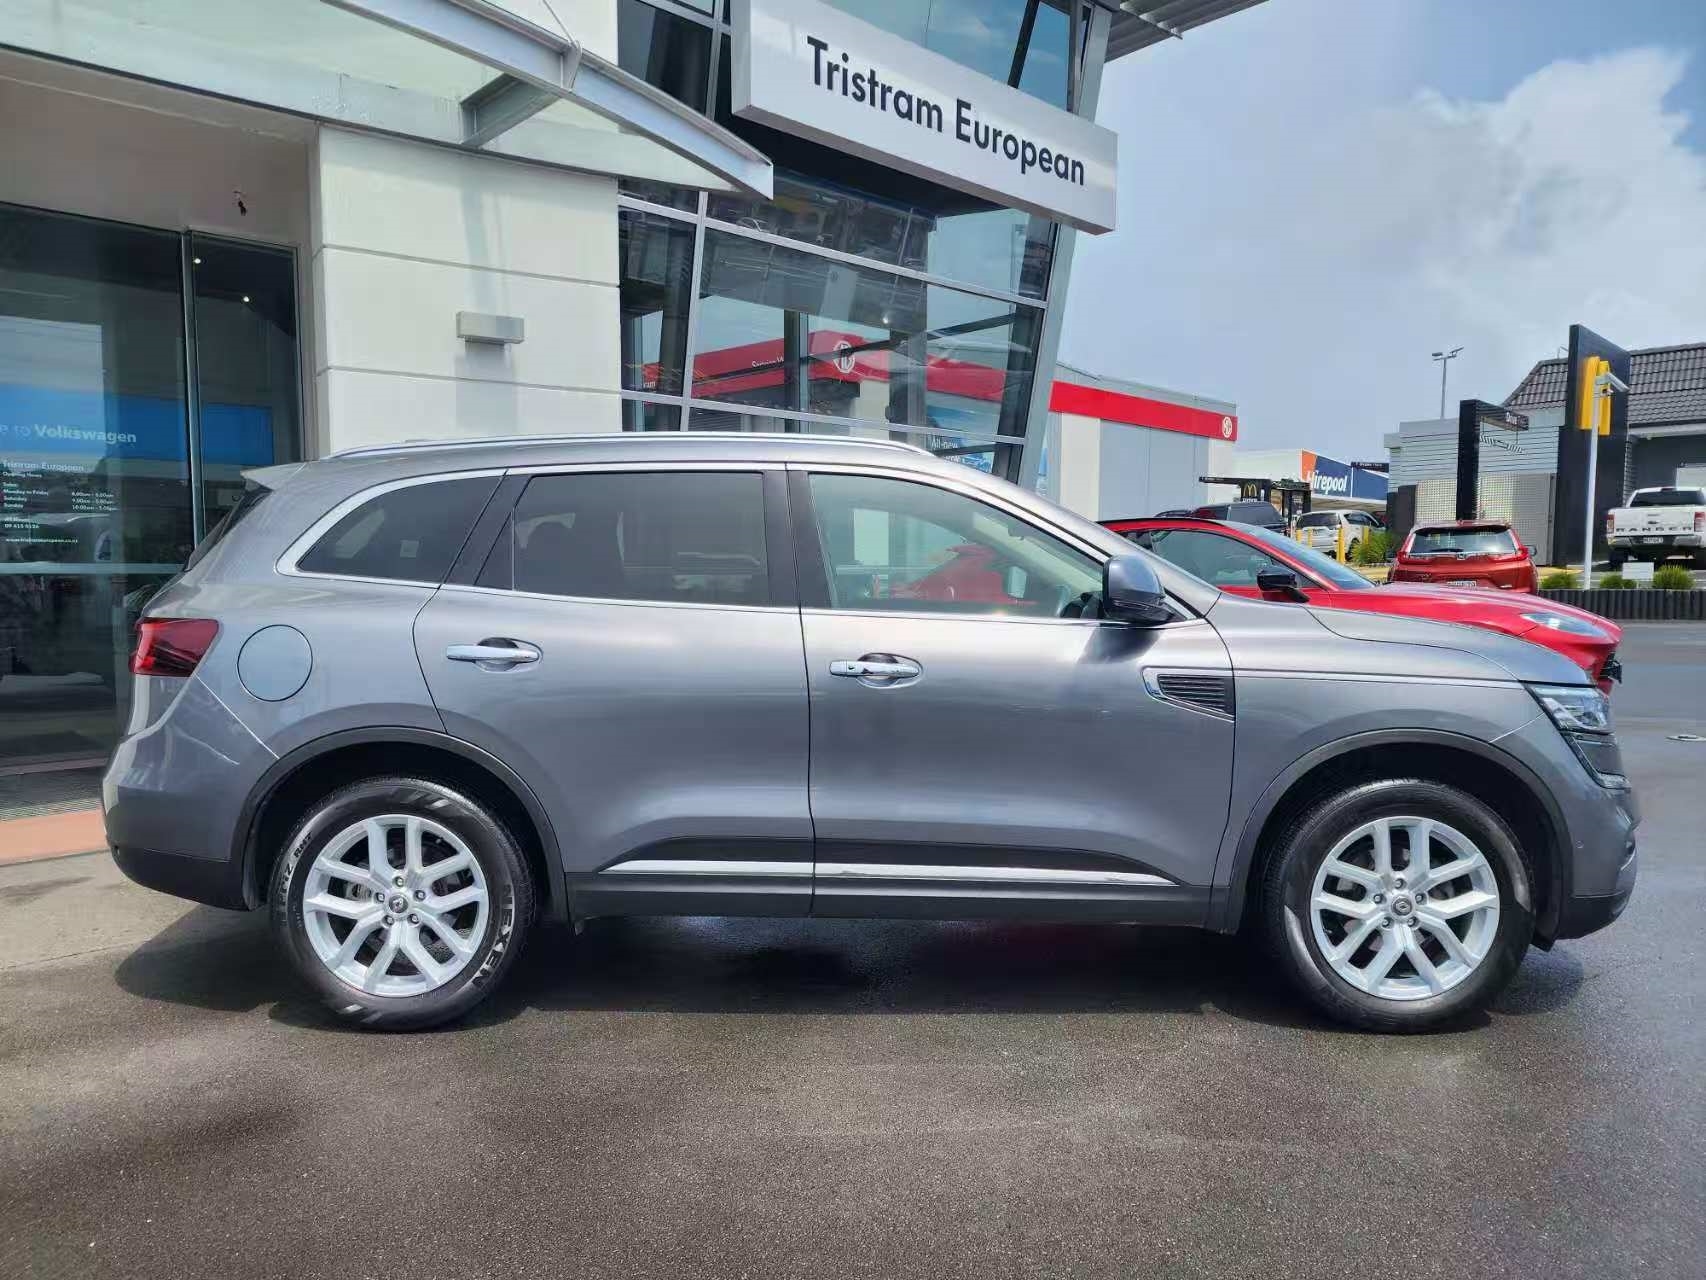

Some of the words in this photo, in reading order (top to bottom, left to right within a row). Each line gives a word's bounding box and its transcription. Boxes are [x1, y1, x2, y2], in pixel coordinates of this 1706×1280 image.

[807, 36, 943, 132] Tristram
[956, 98, 1084, 186] European
[34, 423, 137, 445] Volkswagen
[42, 462, 84, 473] European
[1306, 469, 1348, 496] Hirepool
